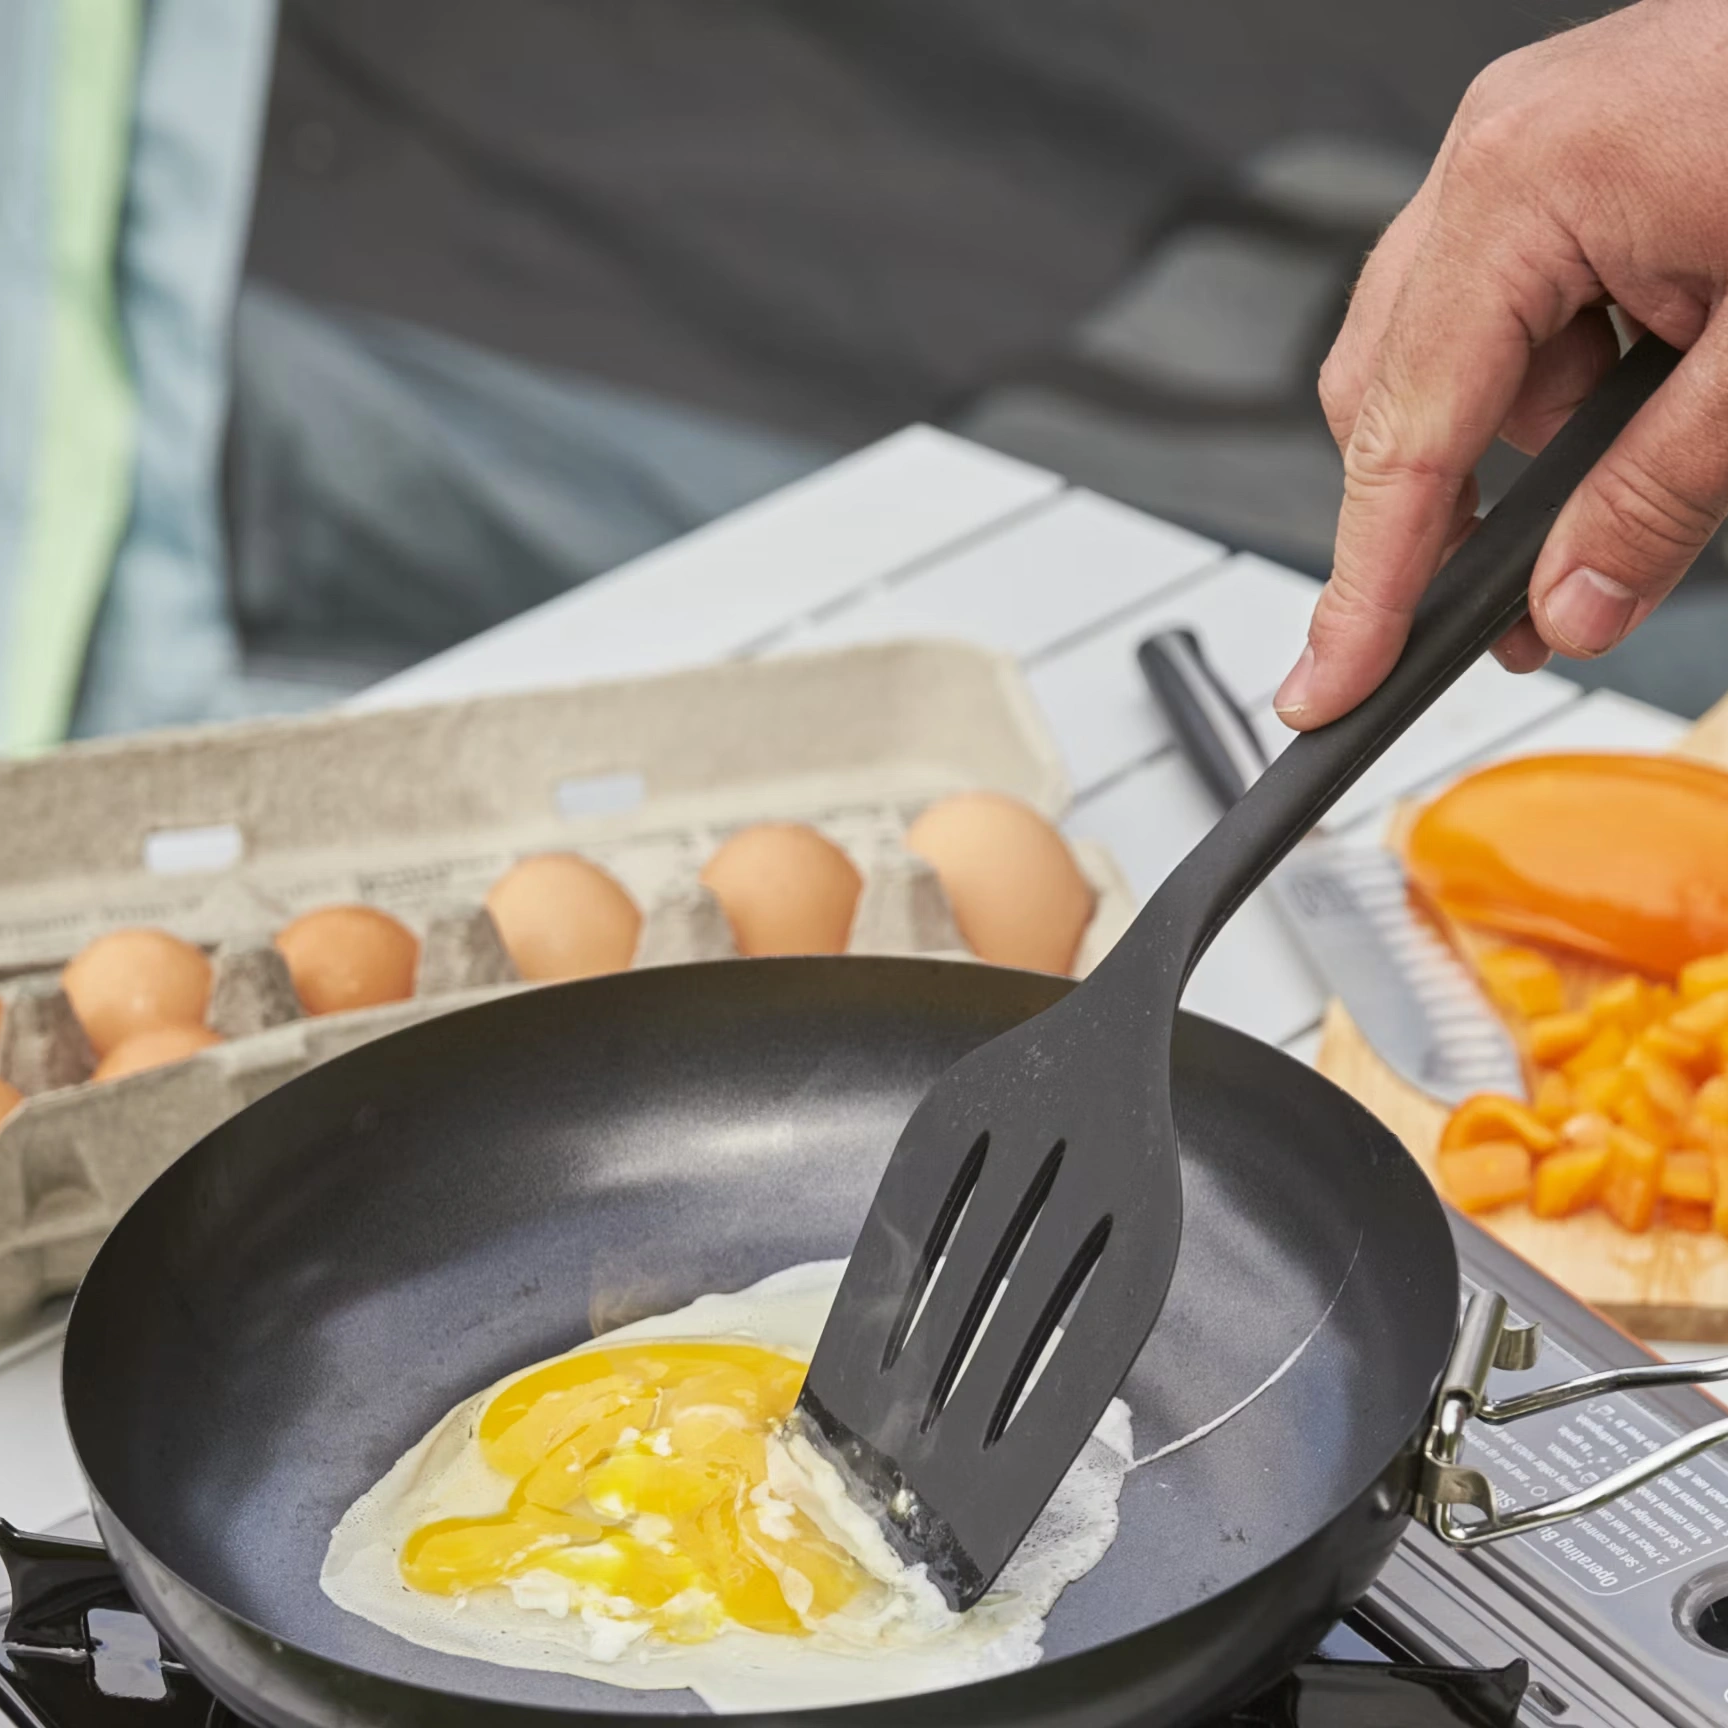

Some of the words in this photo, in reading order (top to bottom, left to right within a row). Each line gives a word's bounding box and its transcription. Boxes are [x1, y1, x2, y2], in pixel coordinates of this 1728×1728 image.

[1576, 1521, 1611, 1544] control
[1555, 1538, 1618, 1587] Operating
[1619, 1553, 1640, 1568] Set
